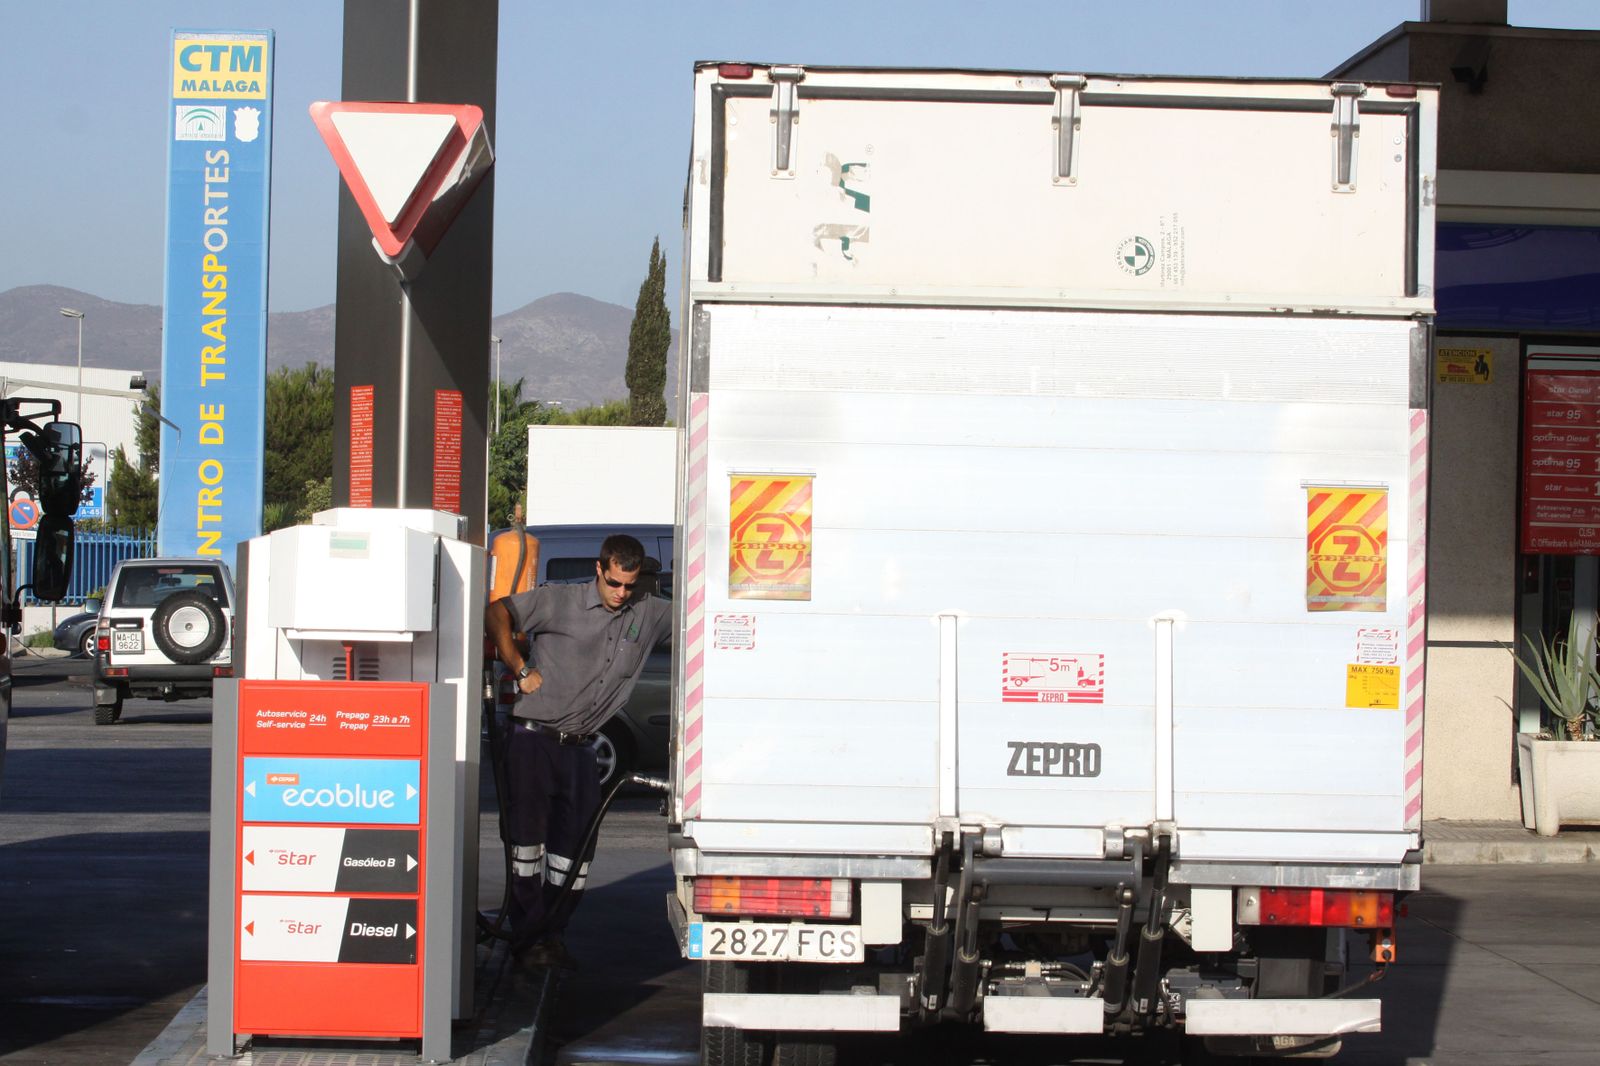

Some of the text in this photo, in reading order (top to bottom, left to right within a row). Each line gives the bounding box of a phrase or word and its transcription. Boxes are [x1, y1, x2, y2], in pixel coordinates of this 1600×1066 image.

[180, 44, 263, 72] CTM
[181, 80, 260, 92] MALAGA
[200, 149, 230, 388] TRANSPORTES
[1546, 409, 1564, 417] star
[1566, 409, 1582, 420] 95
[199, 403, 225, 446] DE
[1532, 456, 1581, 468] optima 95
[196, 459, 223, 560] NTRO
[1310, 554, 1382, 562] ZEPRO
[118, 642, 139, 650] 9622
[1386, 668, 1394, 676] kg
[1041, 692, 1064, 702] ZEPRO
[256, 710, 307, 718] Autoservicio
[309, 714, 327, 722] 24h
[336, 710, 370, 720] Prepago
[372, 715, 390, 724] 23h
[399, 715, 410, 724] 7h
[256, 720, 306, 729] Self-service
[340, 722, 369, 731] Prepay
[1006, 742, 1102, 778] ZEPRO
[282, 783, 395, 809] ecoblue
[278, 852, 316, 866] star
[344, 857, 396, 868] Gasóleo B
[287, 922, 322, 934] star
[350, 922, 398, 937] Diesel
[709, 928, 856, 958] 2827 FCS
